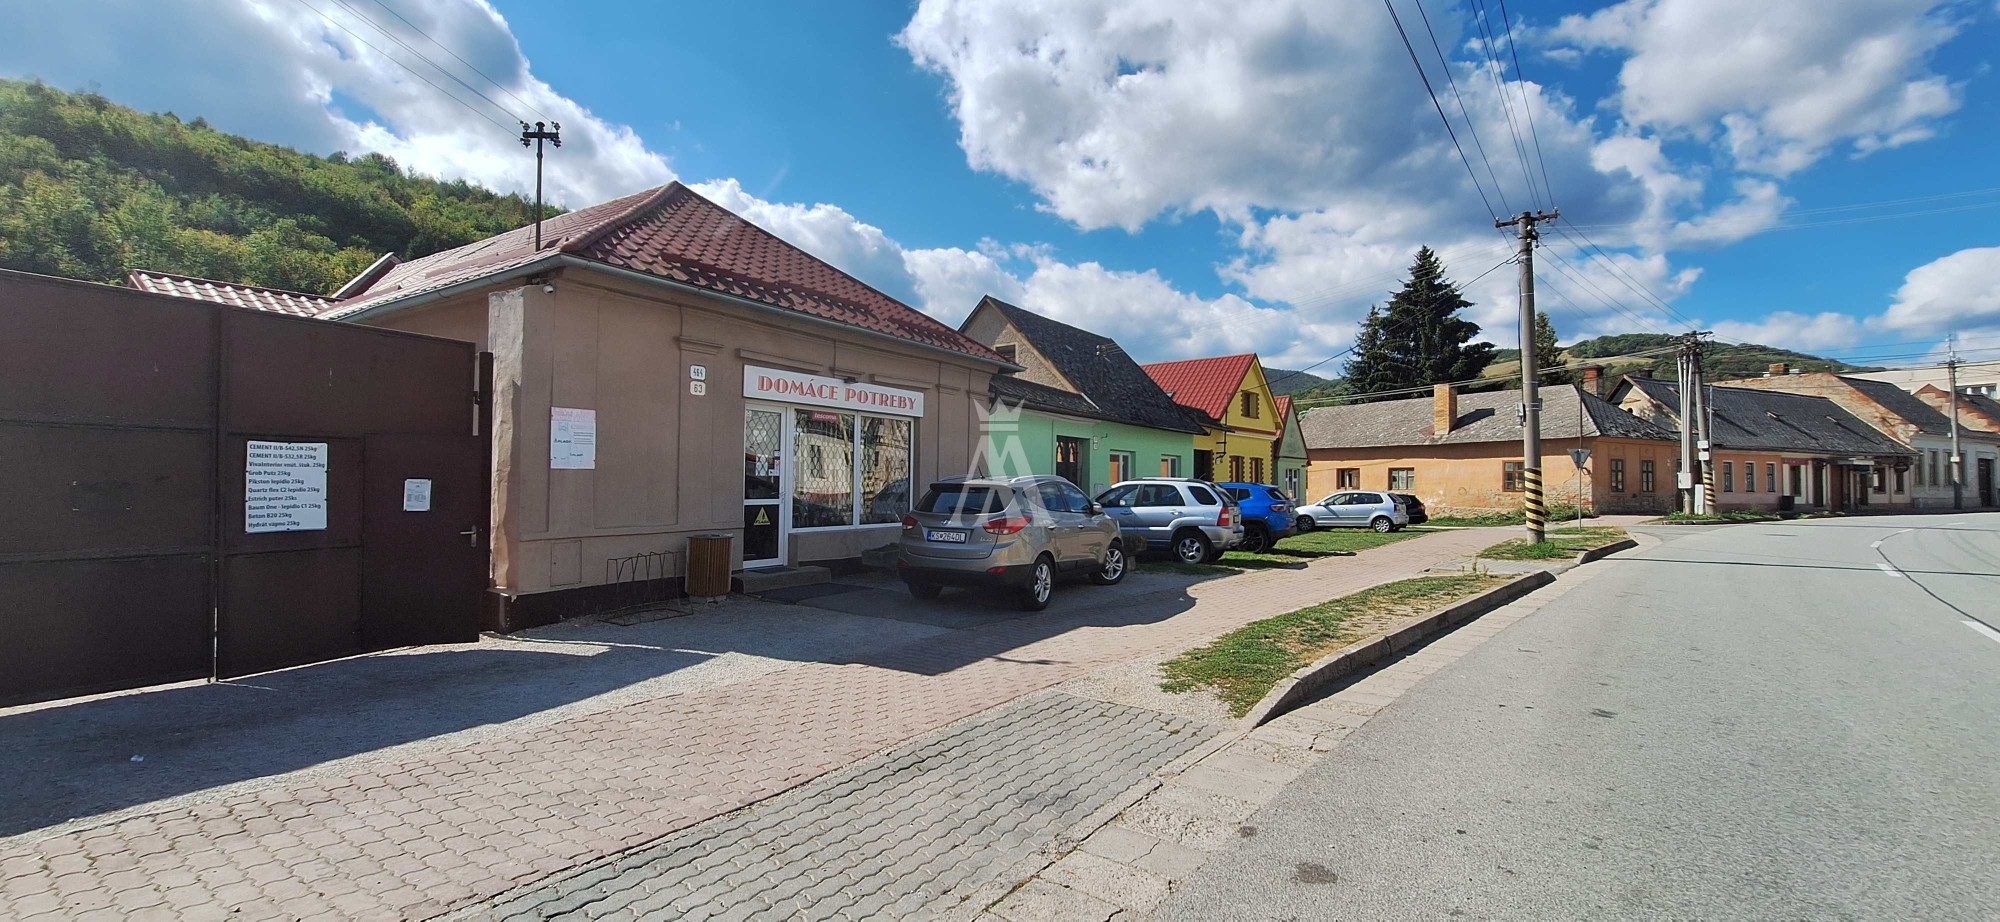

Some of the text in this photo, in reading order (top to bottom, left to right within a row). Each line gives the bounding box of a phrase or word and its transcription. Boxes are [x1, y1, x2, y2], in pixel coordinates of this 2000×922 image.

[694, 384, 703, 393] 63
[757, 375, 917, 410] DOMÁCE POTREBY
